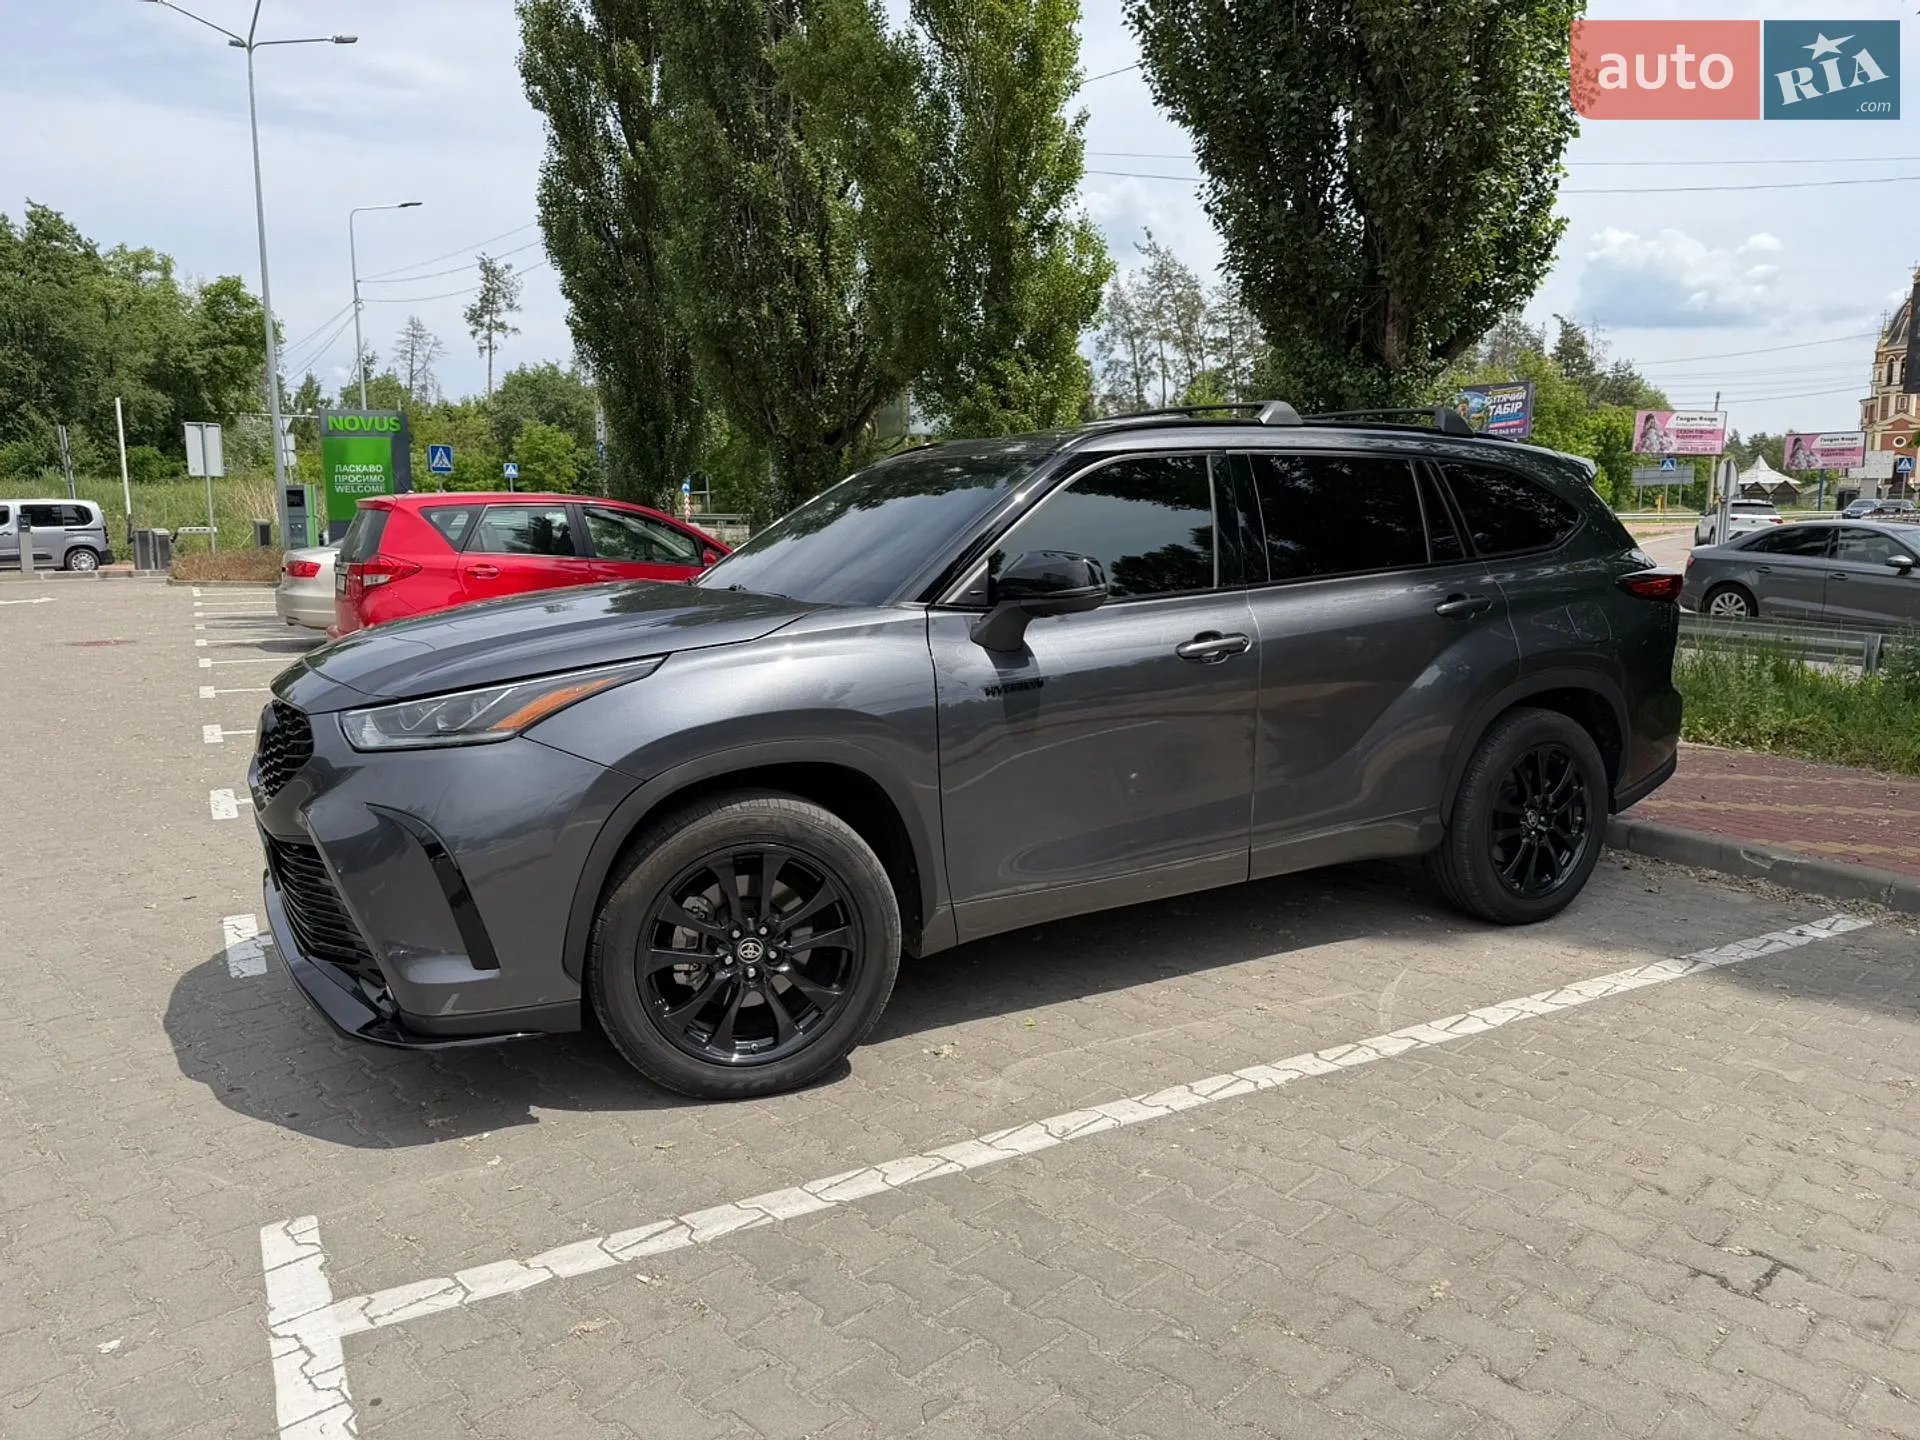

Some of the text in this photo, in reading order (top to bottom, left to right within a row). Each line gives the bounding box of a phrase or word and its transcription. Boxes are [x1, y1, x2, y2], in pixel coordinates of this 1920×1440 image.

[1488, 402, 1523, 416] ТАБІР
[327, 415, 401, 433] NOVUS
[335, 464, 383, 472] ЛАСКАВО
[334, 474, 386, 483] ПРОСИМО
[334, 484, 386, 493] WELCOME
